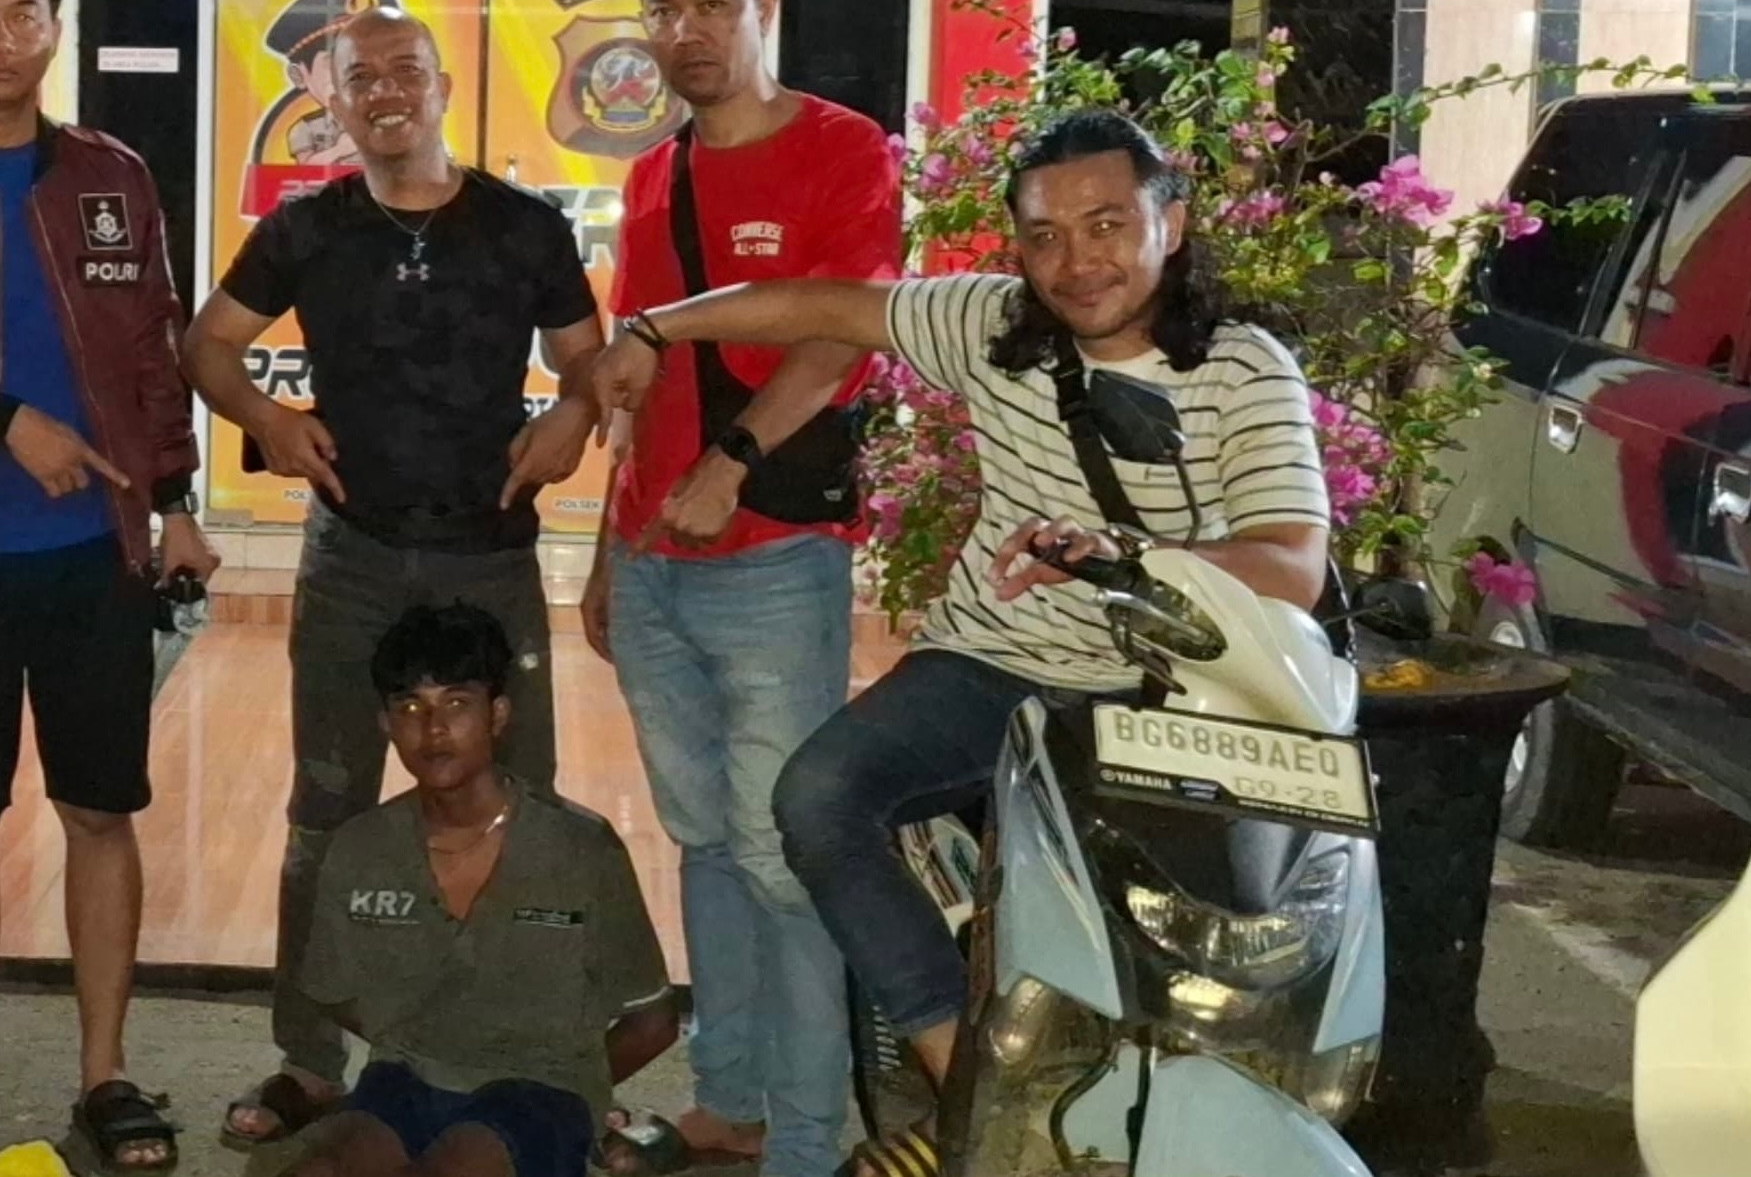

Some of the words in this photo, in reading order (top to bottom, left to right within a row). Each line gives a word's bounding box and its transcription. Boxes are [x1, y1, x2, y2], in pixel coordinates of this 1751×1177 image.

[85, 261, 140, 282] POLRI
[1116, 771, 1173, 791] YAMAHA
[349, 889, 416, 917] KR7
